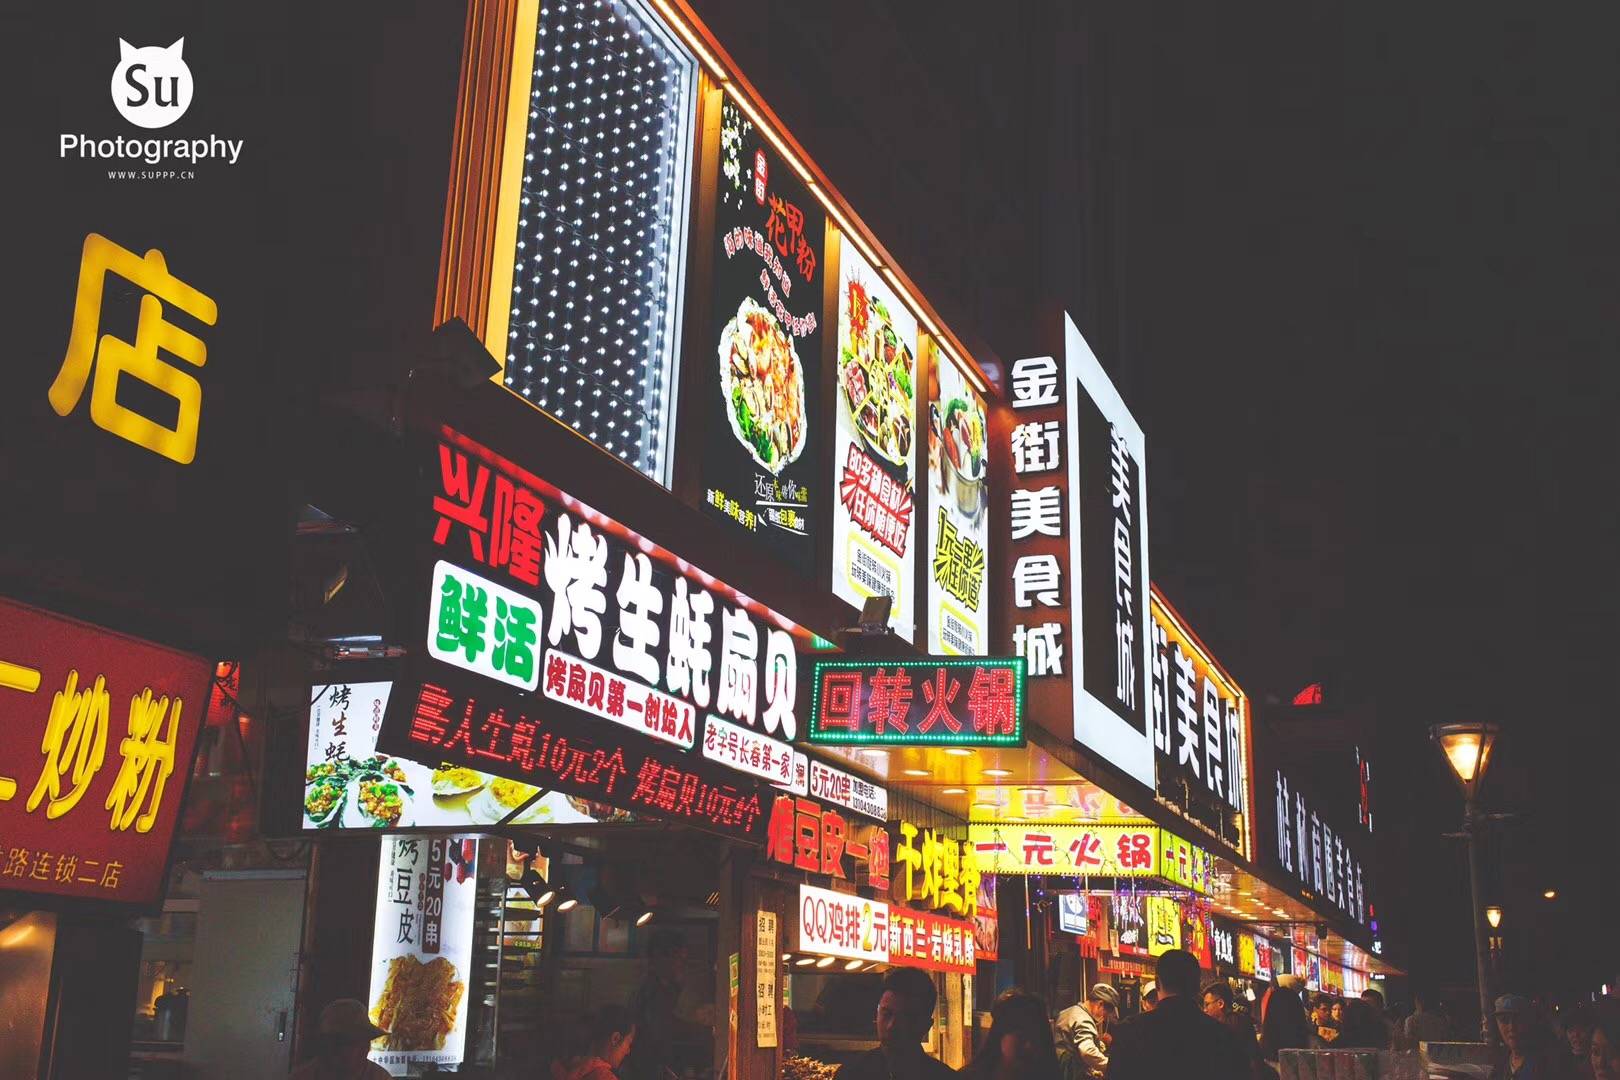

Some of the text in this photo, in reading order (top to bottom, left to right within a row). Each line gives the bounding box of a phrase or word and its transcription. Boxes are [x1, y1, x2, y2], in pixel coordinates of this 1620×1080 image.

[765, 192, 816, 282] 花甲粉
[48, 232, 218, 465] 店
[432, 444, 545, 587] 兴隆
[1010, 355, 1063, 677] 金街美食城
[436, 574, 537, 683] 鲜活
[544, 513, 798, 741] 烤生蚝扇贝
[325, 685, 353, 762] 烤生蚝
[546, 653, 694, 743] 烤扇贝第一创始人
[820, 666, 1016, 736] 回转火锅
[0, 661, 182, 833] 炒粉
[704, 722, 791, 779] 老字号长春第一家
[811, 765, 851, 807] 5元20串
[4, 848, 124, 889] 路连锁二店
[393, 839, 422, 945] 烤豆皮
[425, 840, 442, 945] 5元20串
[975, 833, 1152, 869] 一元火锅
[803, 895, 888, 952] QQ鸡排2元
